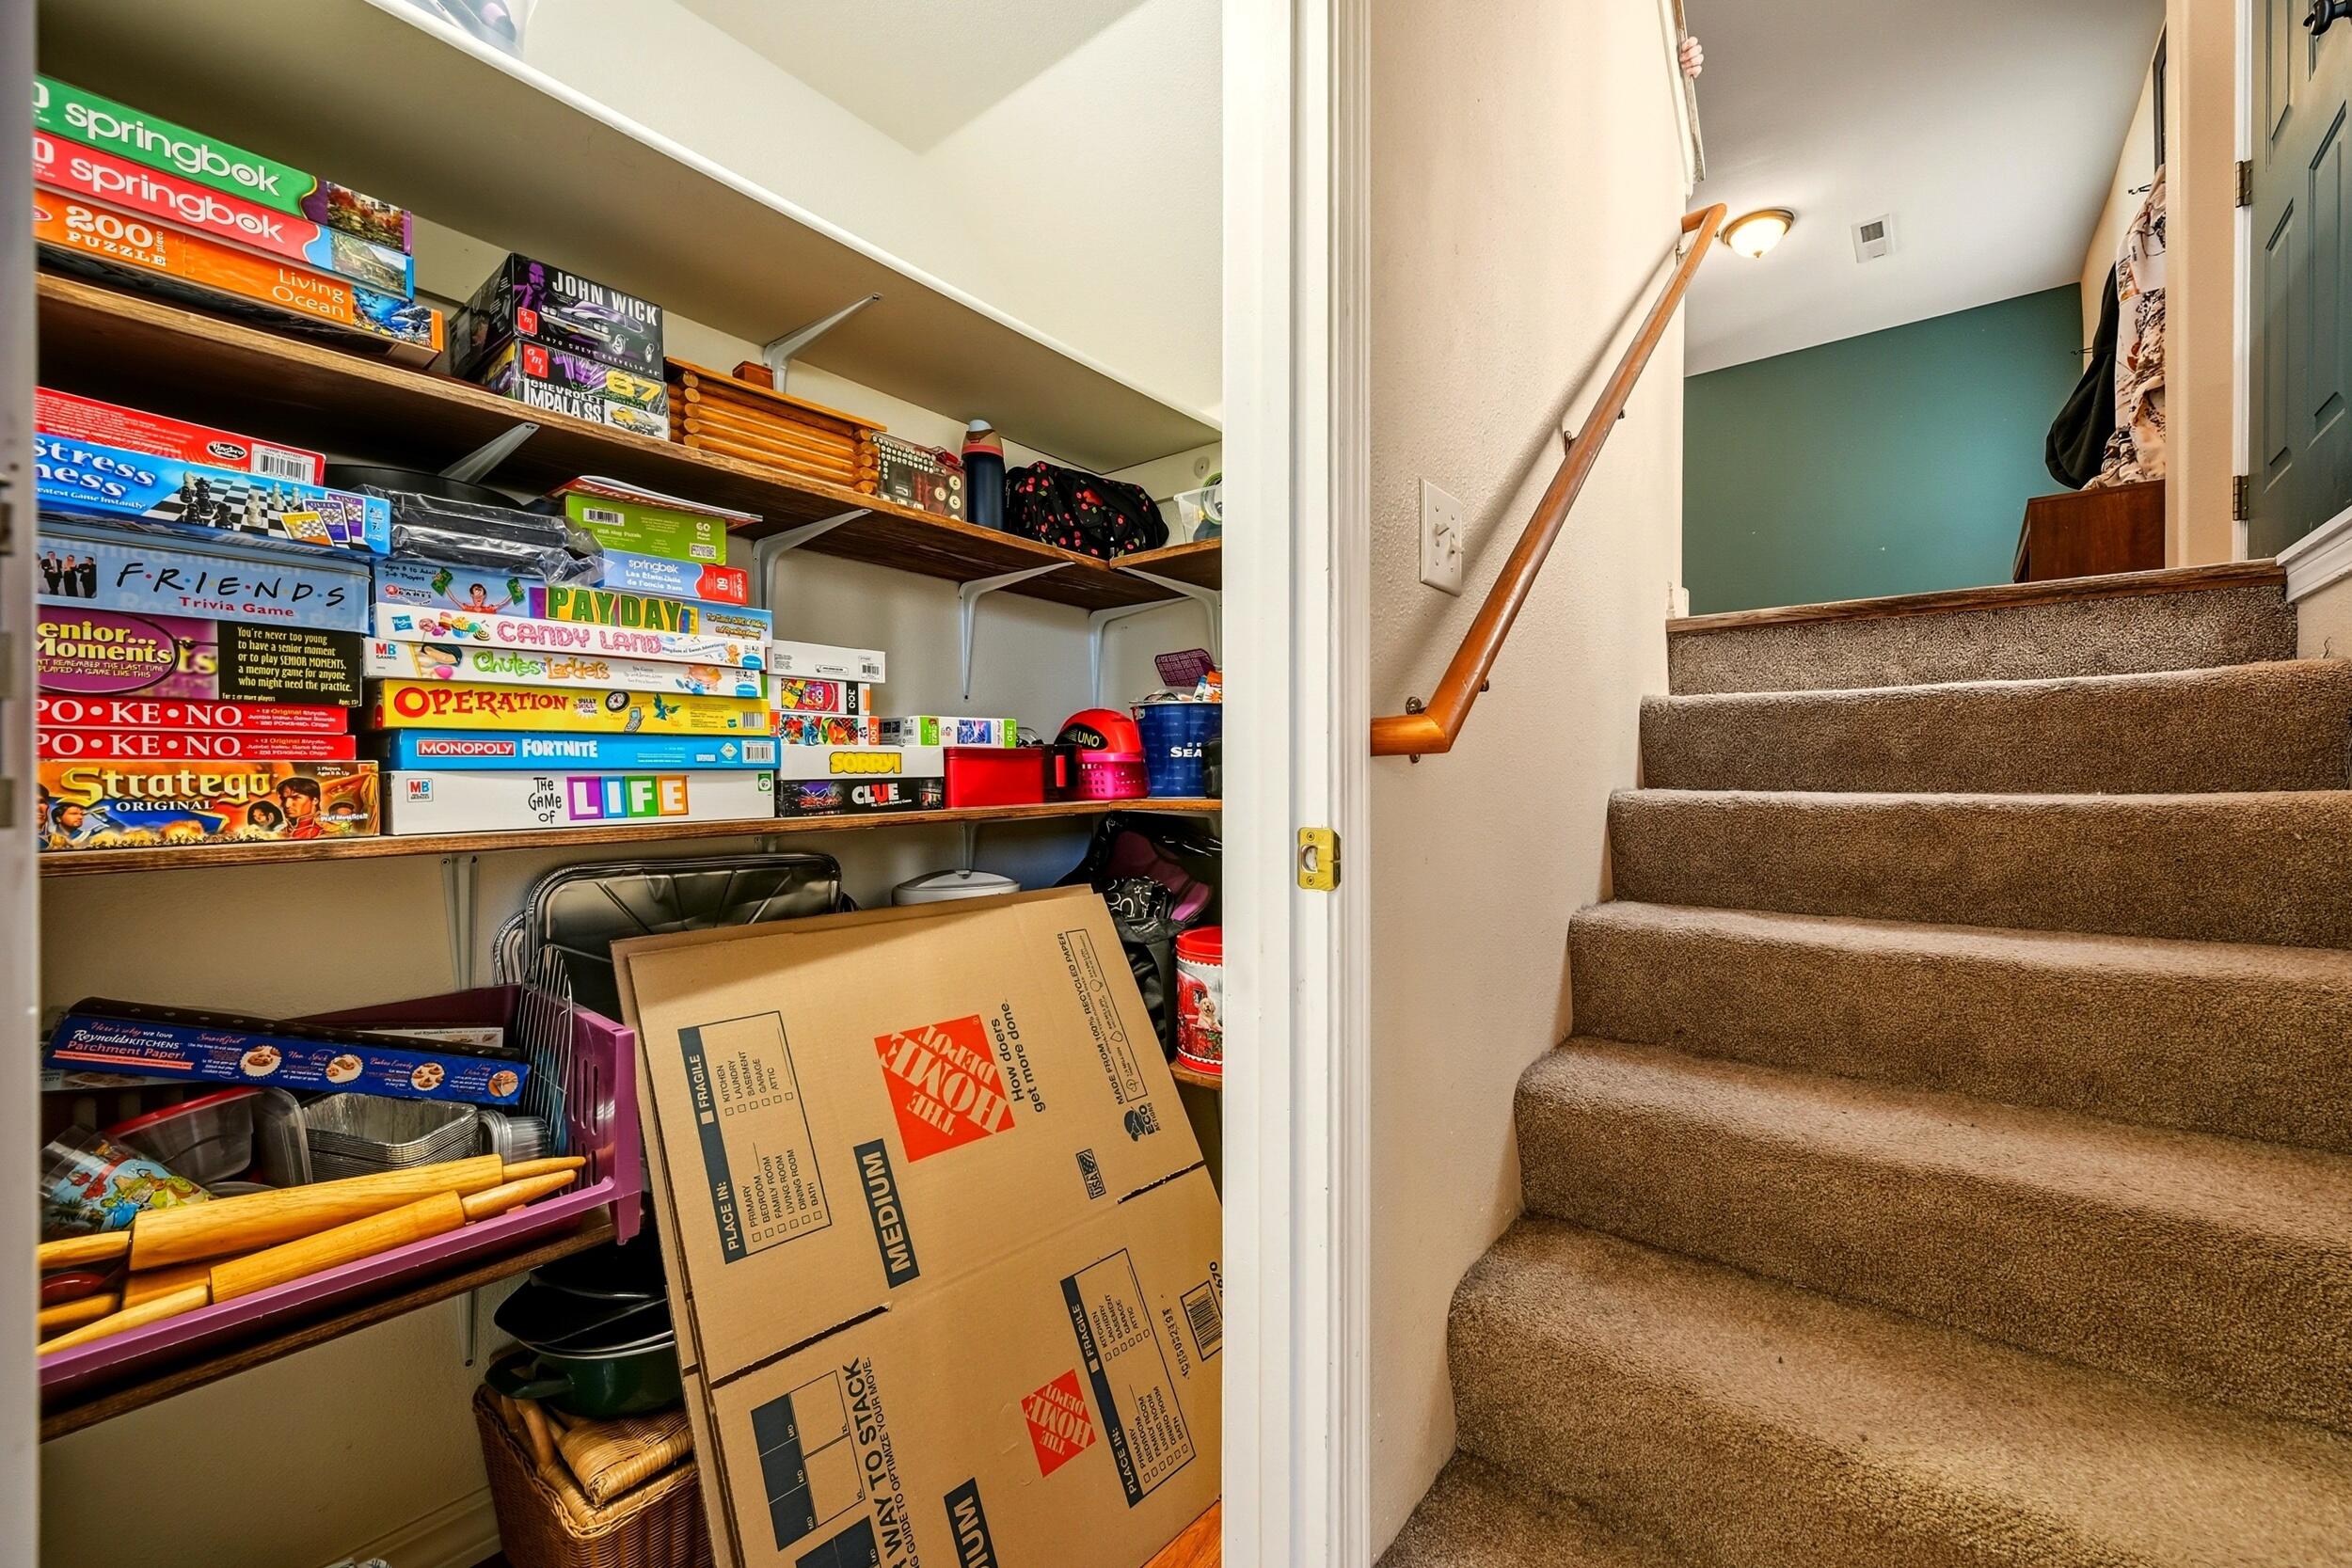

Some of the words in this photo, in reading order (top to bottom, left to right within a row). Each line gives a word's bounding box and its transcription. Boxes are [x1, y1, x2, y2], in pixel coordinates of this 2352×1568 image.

[64, 101, 282, 197] springbok
[70, 155, 285, 243] springbok
[65, 204, 153, 249] 200
[67, 230, 167, 268] PUZZLE
[272, 284, 344, 318] Ocean
[278, 268, 344, 304] Living
[552, 271, 603, 306] JOHN
[612, 292, 658, 326] WICK
[524, 378, 580, 420] IMPALA
[583, 402, 601, 422] SS
[531, 381, 602, 404] CHEVROLET
[606, 371, 661, 402] 67
[71, 492, 99, 501] Game
[628, 560, 678, 573] springbok
[179, 595, 234, 612] Trivia
[243, 602, 294, 617] Game
[548, 586, 683, 633] PAYDAY
[237, 626, 262, 638] You're
[265, 631, 286, 641] never
[305, 635, 327, 645] young
[238, 641, 246, 649] to
[249, 641, 268, 651] have
[278, 642, 301, 653] senior
[304, 646, 336, 656] moment
[375, 643, 397, 655] MB
[497, 621, 590, 649] CANDY
[599, 631, 662, 654] LAND
[54, 659, 100, 669] REMEMBER
[114, 669, 130, 677] LIKE
[238, 653, 247, 661] or
[250, 654, 259, 662] to
[262, 654, 278, 665] play
[280, 656, 307, 666] SENIOR
[246, 666, 279, 676] memory
[282, 669, 303, 678] game
[305, 668, 316, 677] for
[319, 670, 345, 680] anyone
[473, 650, 542, 677] Chutes
[543, 655, 610, 679] Ladders
[239, 676, 256, 687] who
[258, 677, 282, 689] might
[285, 680, 303, 689] need
[306, 680, 318, 689] the
[321, 682, 352, 692] practice.
[394, 687, 569, 719] OPERATION
[421, 742, 513, 754] MONOPOLY
[521, 738, 598, 758] FORTNITE
[1077, 731, 1099, 747] UNO
[829, 752, 902, 774] SORRY!
[57, 762, 272, 807] Stratego
[410, 781, 430, 793] MB
[573, 780, 684, 816] LIFE
[851, 783, 900, 804] CLUE
[116, 800, 214, 813] ORIGINAL
[1057, 933, 1074, 963] PAPER
[1069, 964, 1092, 1015] RECYCLED
[1000, 999, 1020, 1038] done.
[68, 1040, 141, 1056] Parchment
[144, 1048, 185, 1059] Paper!
[72, 1029, 129, 1044] Reynolds
[129, 1038, 179, 1049] KITCHENS
[918, 1023, 997, 1085] DEPOT
[991, 1018, 1012, 1062] doers
[739, 1051, 755, 1097] BASEMENT
[1012, 1043, 1034, 1080] more
[1097, 1043, 1113, 1072] FROM
[690, 1053, 710, 1108] FRAGILE
[717, 1065, 730, 1103] KITCHEN
[727, 1060, 742, 1100] LAUNDRY
[752, 1058, 768, 1094] GARAGE
[768, 1067, 779, 1091] ATTIC
[880, 1033, 1009, 1134] HOME
[1007, 1065, 1025, 1102] How
[1108, 1074, 1124, 1105] MADE
[906, 1091, 958, 1136] THE
[1026, 1084, 1046, 1114] get
[1139, 1105, 1155, 1134] ECO
[1147, 1102, 1161, 1131] ACTIONS
[762, 1156, 775, 1184] ROOM
[775, 1155, 787, 1181] ROOM
[787, 1148, 800, 1176] ROOM
[716, 1180, 730, 1200] IN:
[754, 1175, 771, 1224] BEDROOM
[781, 1181, 794, 1214] LIVING
[794, 1176, 806, 1211] DINING
[808, 1182, 818, 1206] BATH
[1092, 1172, 1103, 1196] USA
[742, 1185, 756, 1227] PRIMARY
[768, 1185, 782, 1219] FAMILY
[862, 1150, 911, 1274] MEDIUM
[719, 1202, 739, 1251] PLACE
[1210, 1261, 1222, 1297] 670
[1072, 1305, 1094, 1357] FRAGILE
[863, 1357, 878, 1395] MOVE.
[843, 1357, 877, 1447] STACK
[870, 1396, 886, 1433] YOUR
[1042, 1384, 1085, 1416] DEPOT
[1025, 1392, 1092, 1449] HOME
[1040, 1431, 1065, 1455] THE
[1111, 1427, 1122, 1448] IN:
[865, 1450, 887, 1491] TO
[879, 1432, 900, 1492] OPTIMIZE
[1117, 1449, 1137, 1495] PLACE
[892, 1493, 904, 1513] TO
[874, 1497, 902, 1559] WAY
[898, 1513, 915, 1553] GUIDE
